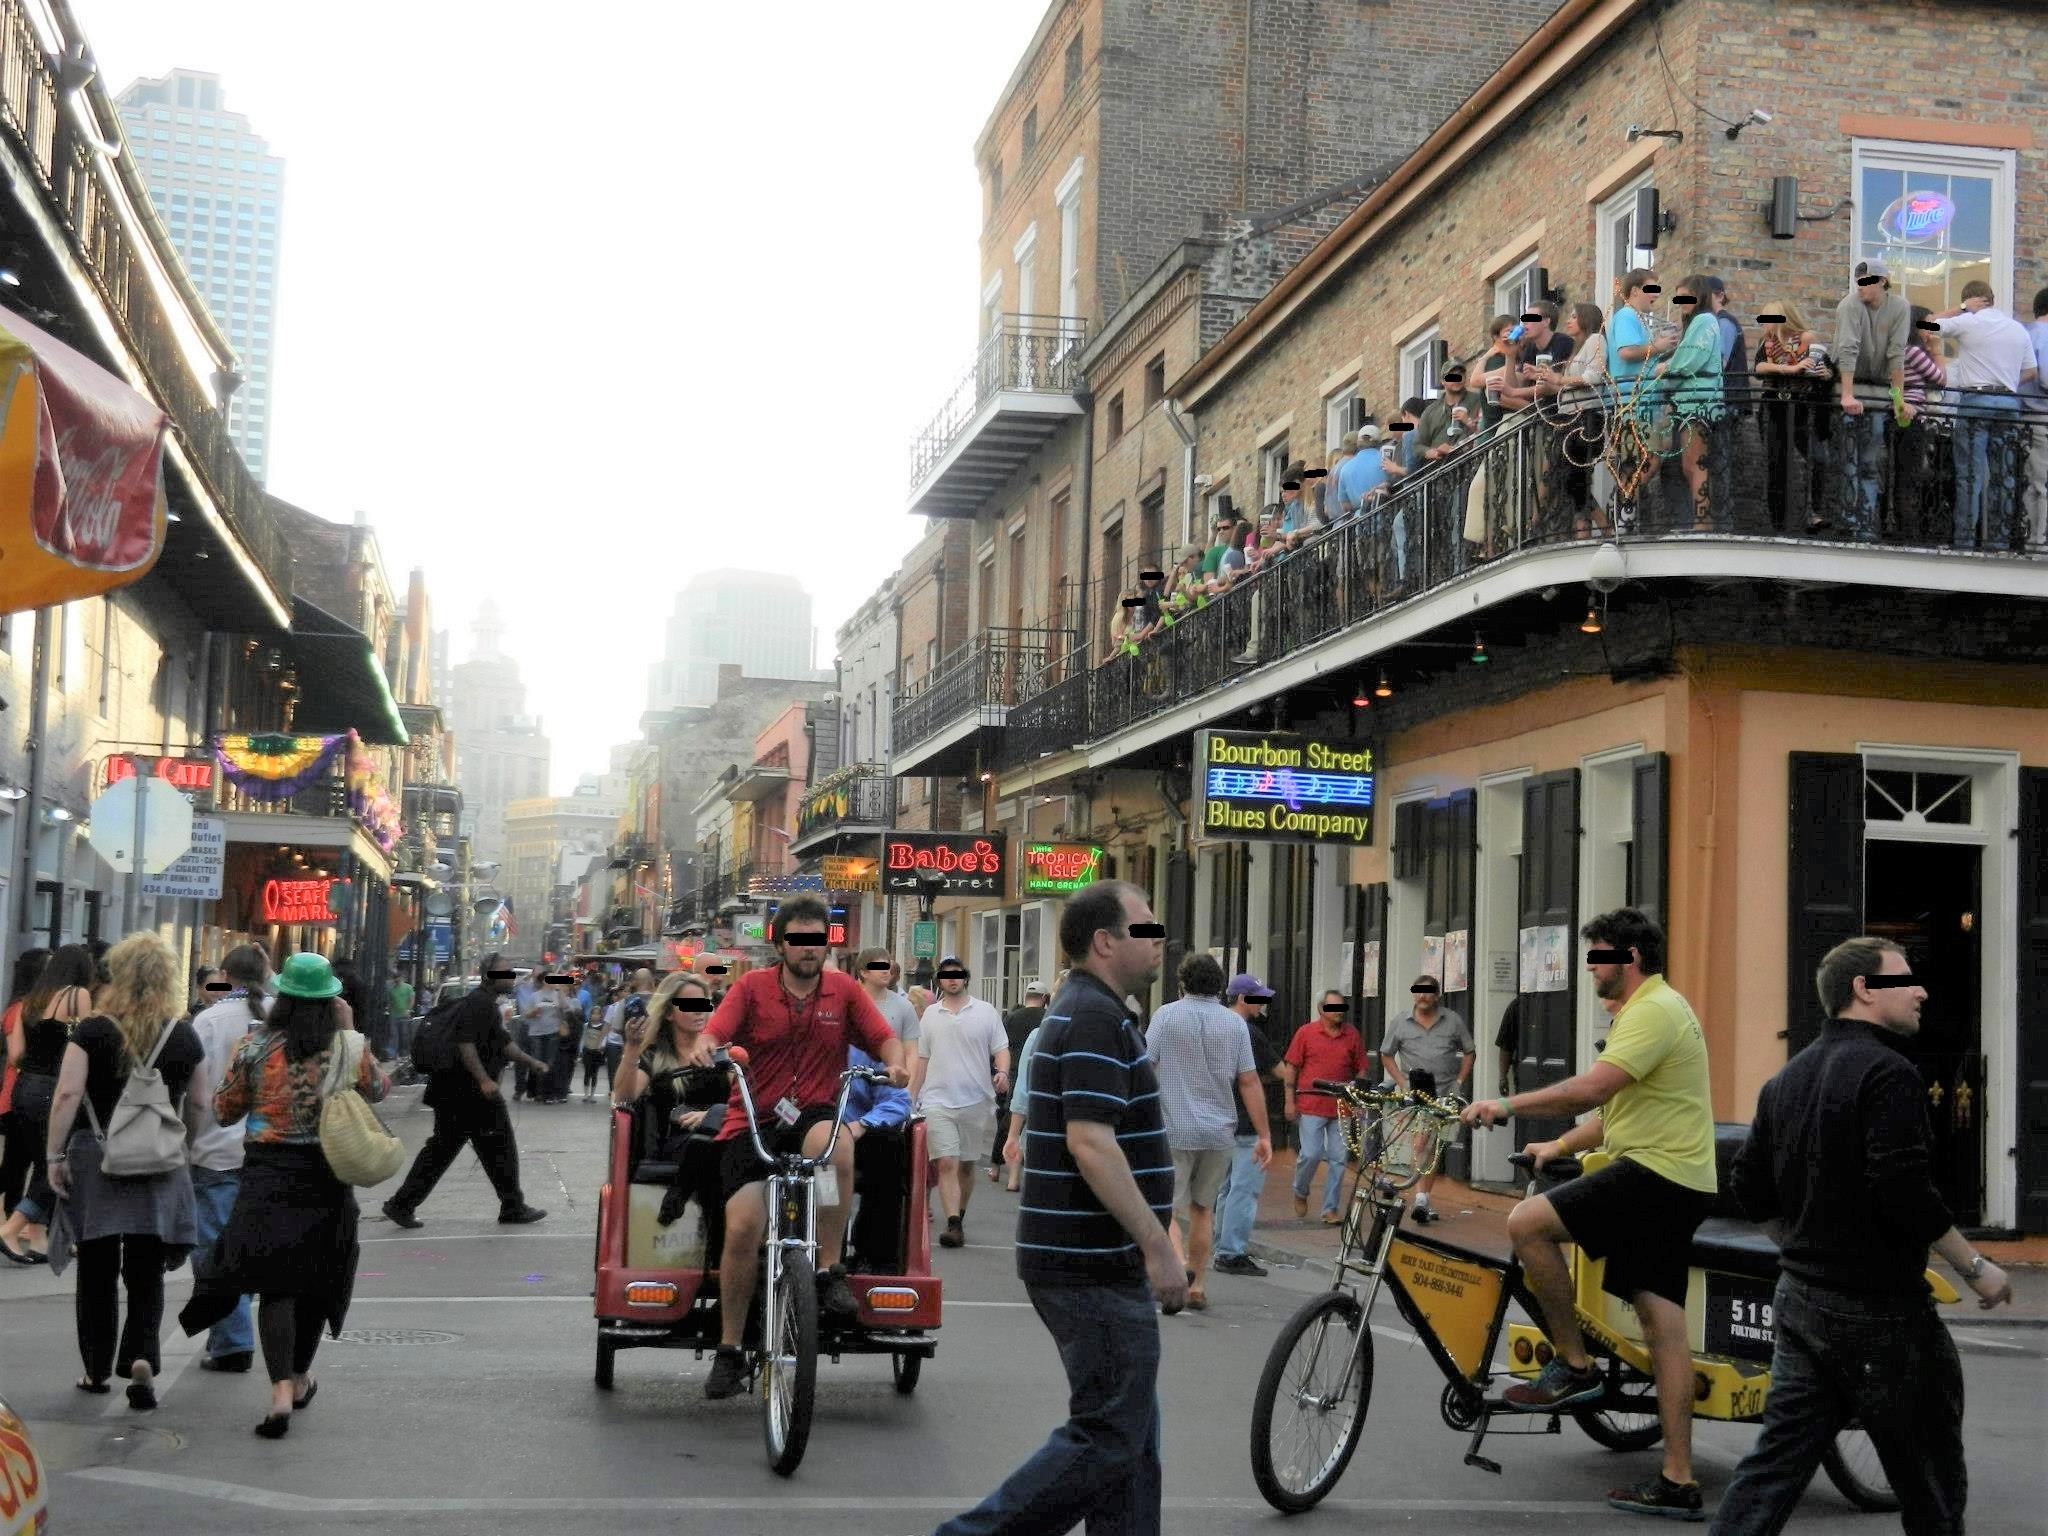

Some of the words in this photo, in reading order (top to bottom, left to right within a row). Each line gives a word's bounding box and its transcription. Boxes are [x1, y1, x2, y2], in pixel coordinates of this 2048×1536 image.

[1210, 736, 1300, 767] Bourbon
[1307, 743, 1372, 773] Street
[1207, 800, 1266, 829] Blues
[1270, 803, 1368, 841] Company
[890, 842, 999, 873] Babe's
[1028, 851, 1098, 866] TROPICAL
[175, 865, 218, 874] CIGARETTES
[1049, 865, 1079, 878] ISLE
[143, 884, 162, 894] 434
[890, 877, 994, 889] caaret
[1030, 880, 1054, 889] HAND
[1056, 881, 1087, 889] GRENA
[282, 904, 334, 921] MARK
[1731, 1299, 1773, 1327] 519
[1731, 1323, 1761, 1340] FULTON
